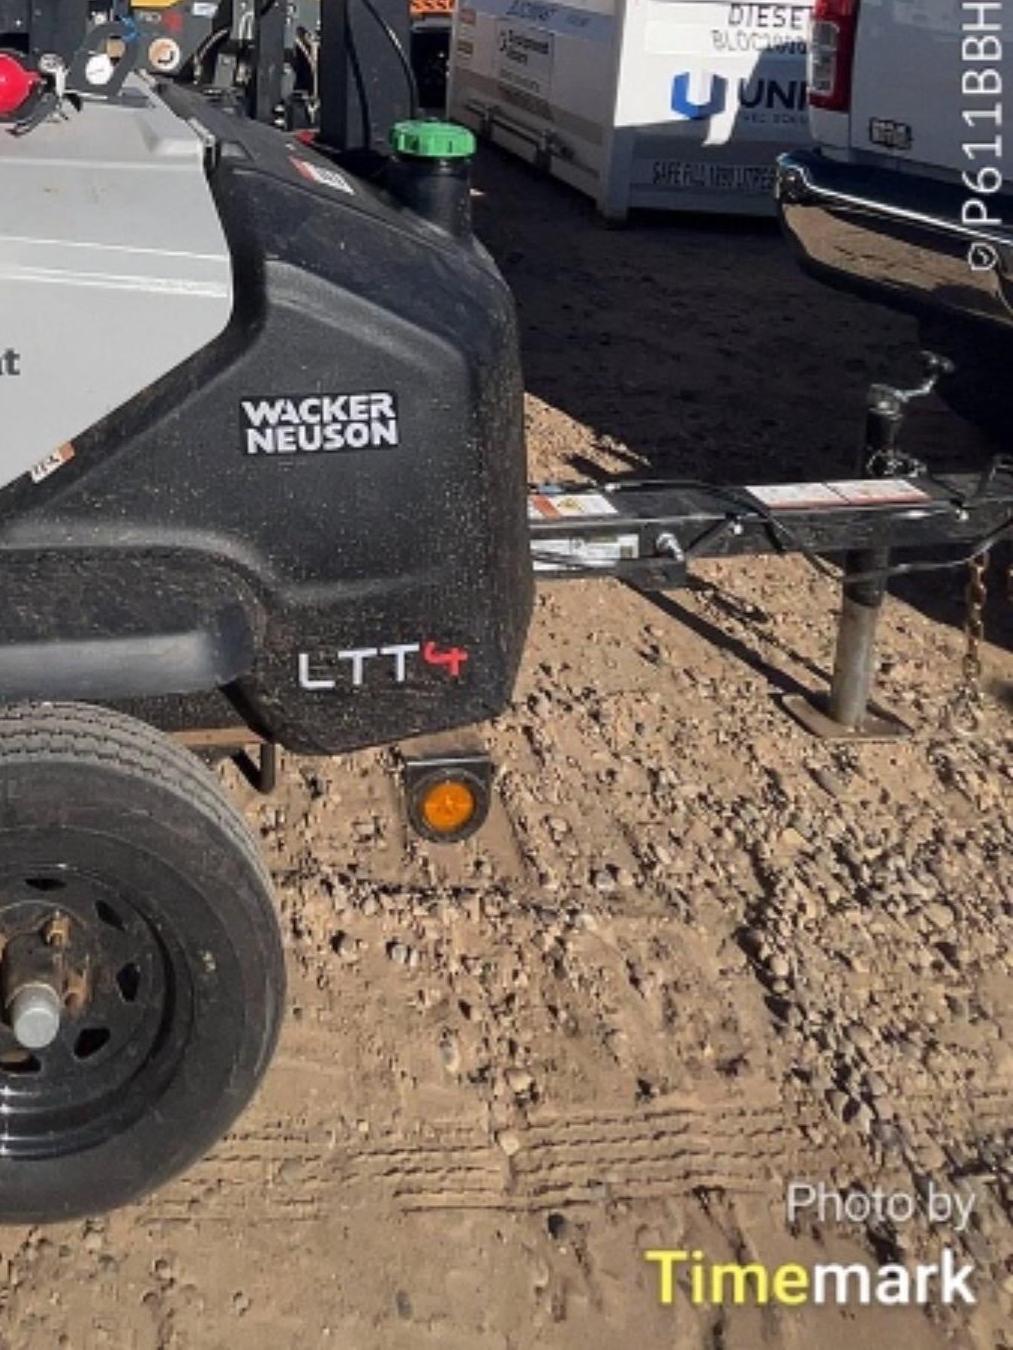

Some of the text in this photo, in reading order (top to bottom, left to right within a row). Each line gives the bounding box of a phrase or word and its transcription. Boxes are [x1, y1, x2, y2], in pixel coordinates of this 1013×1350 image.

[728, 2, 808, 29] DIESE
[739, 78, 807, 111] UNI
[241, 392, 396, 426] WACKER
[246, 419, 398, 454] NEUSON
[298, 641, 468, 690] LTT4
